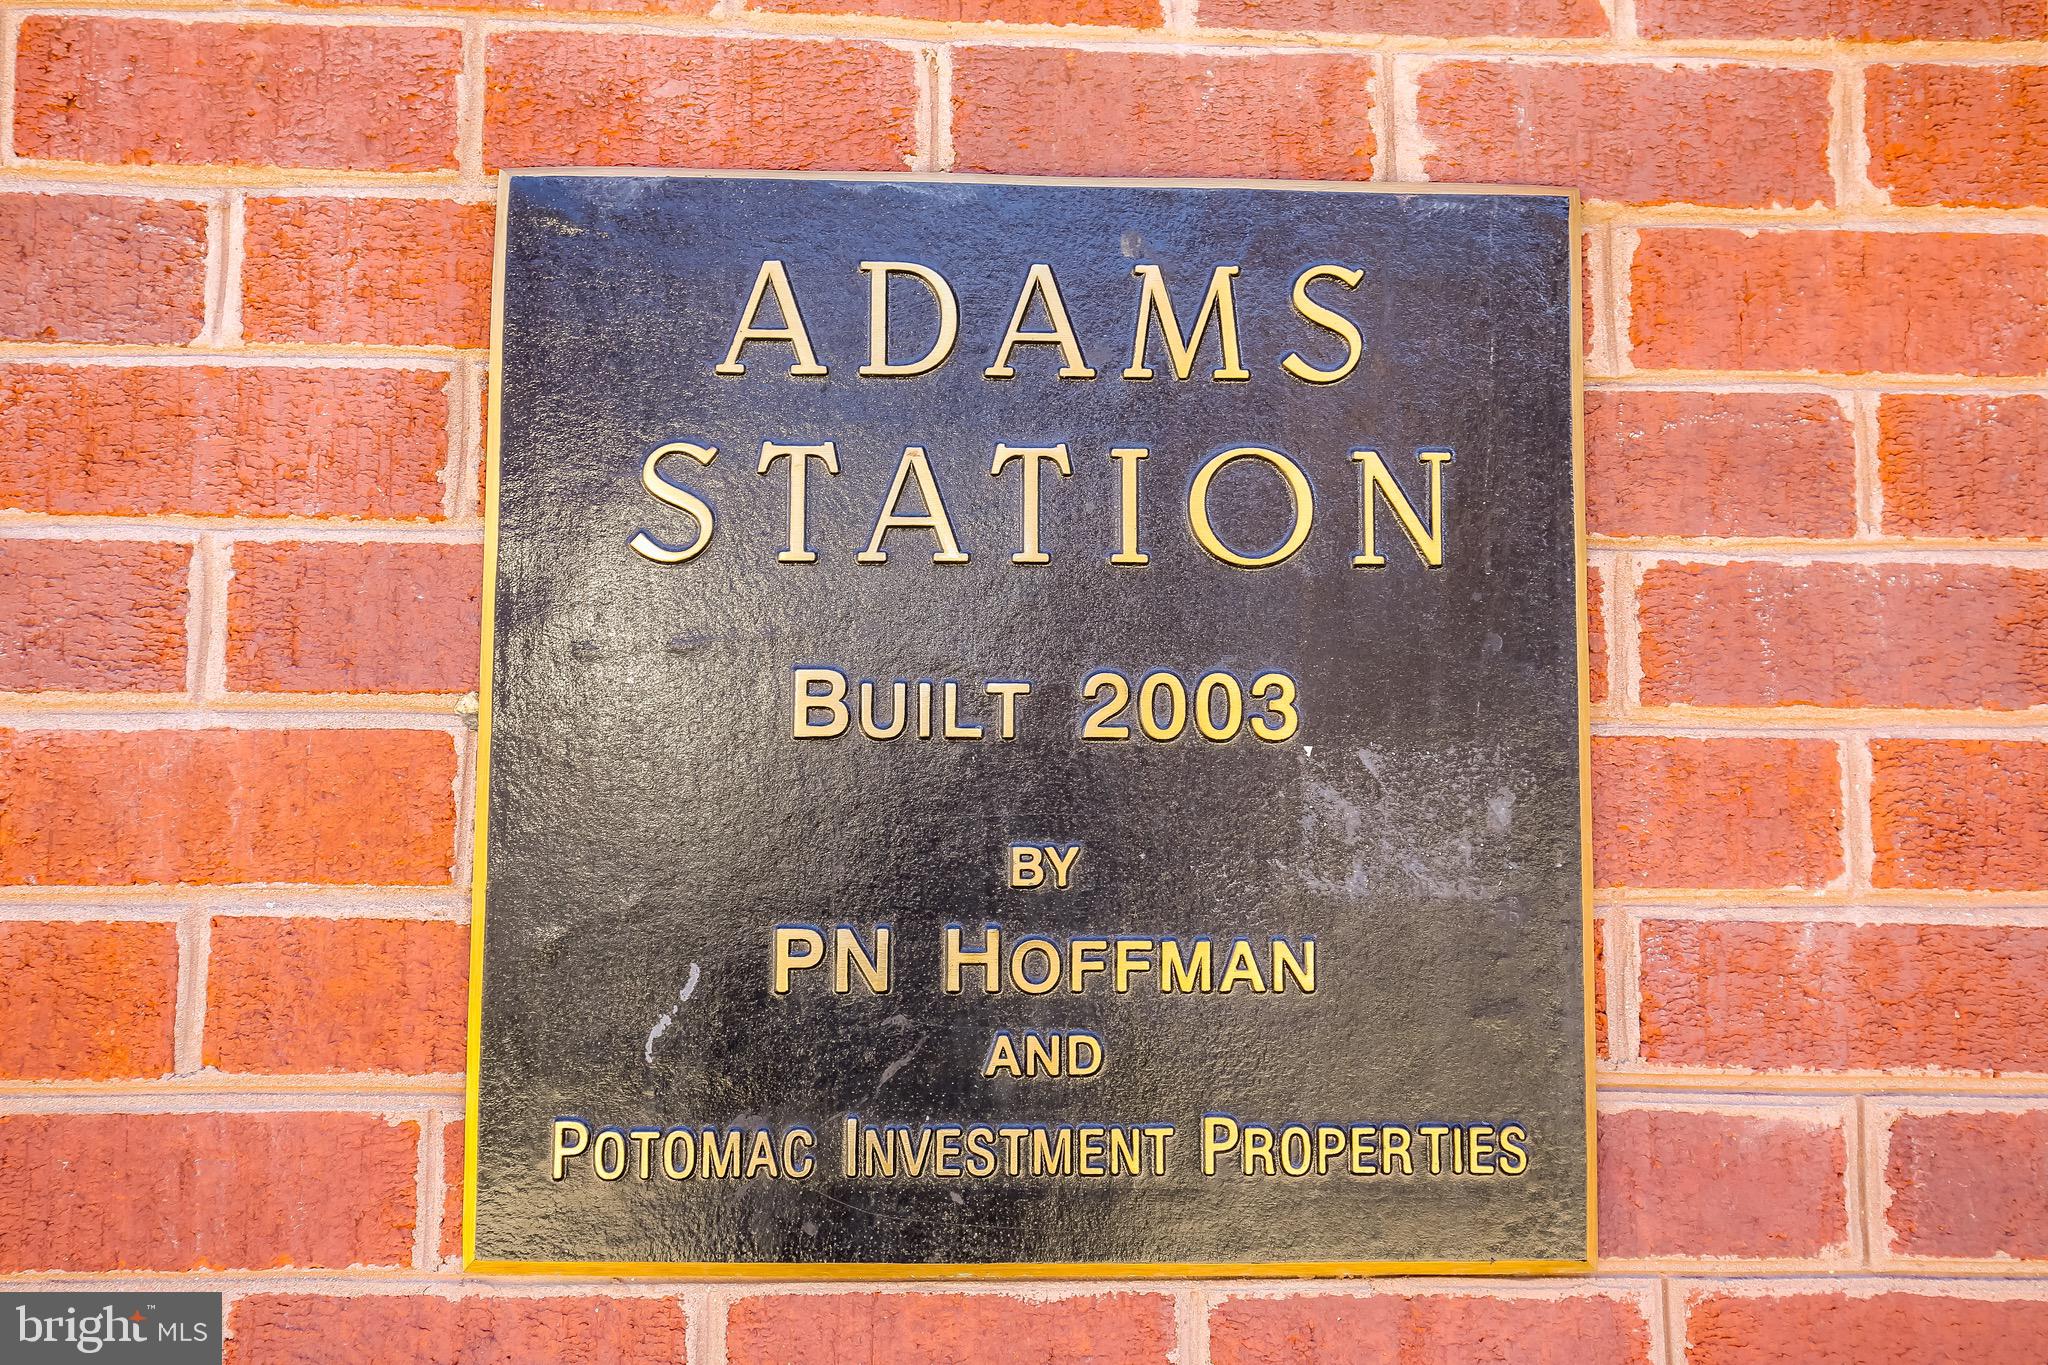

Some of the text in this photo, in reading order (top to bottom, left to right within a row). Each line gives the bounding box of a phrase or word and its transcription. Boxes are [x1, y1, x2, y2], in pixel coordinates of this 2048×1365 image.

[716, 258, 1366, 384] ADAMS
[629, 439, 1454, 567] STATION
[1081, 670, 1300, 743] 2003
[1009, 844, 1080, 889] BY
[772, 926, 891, 995] PN
[985, 1034, 1104, 1077] AND
